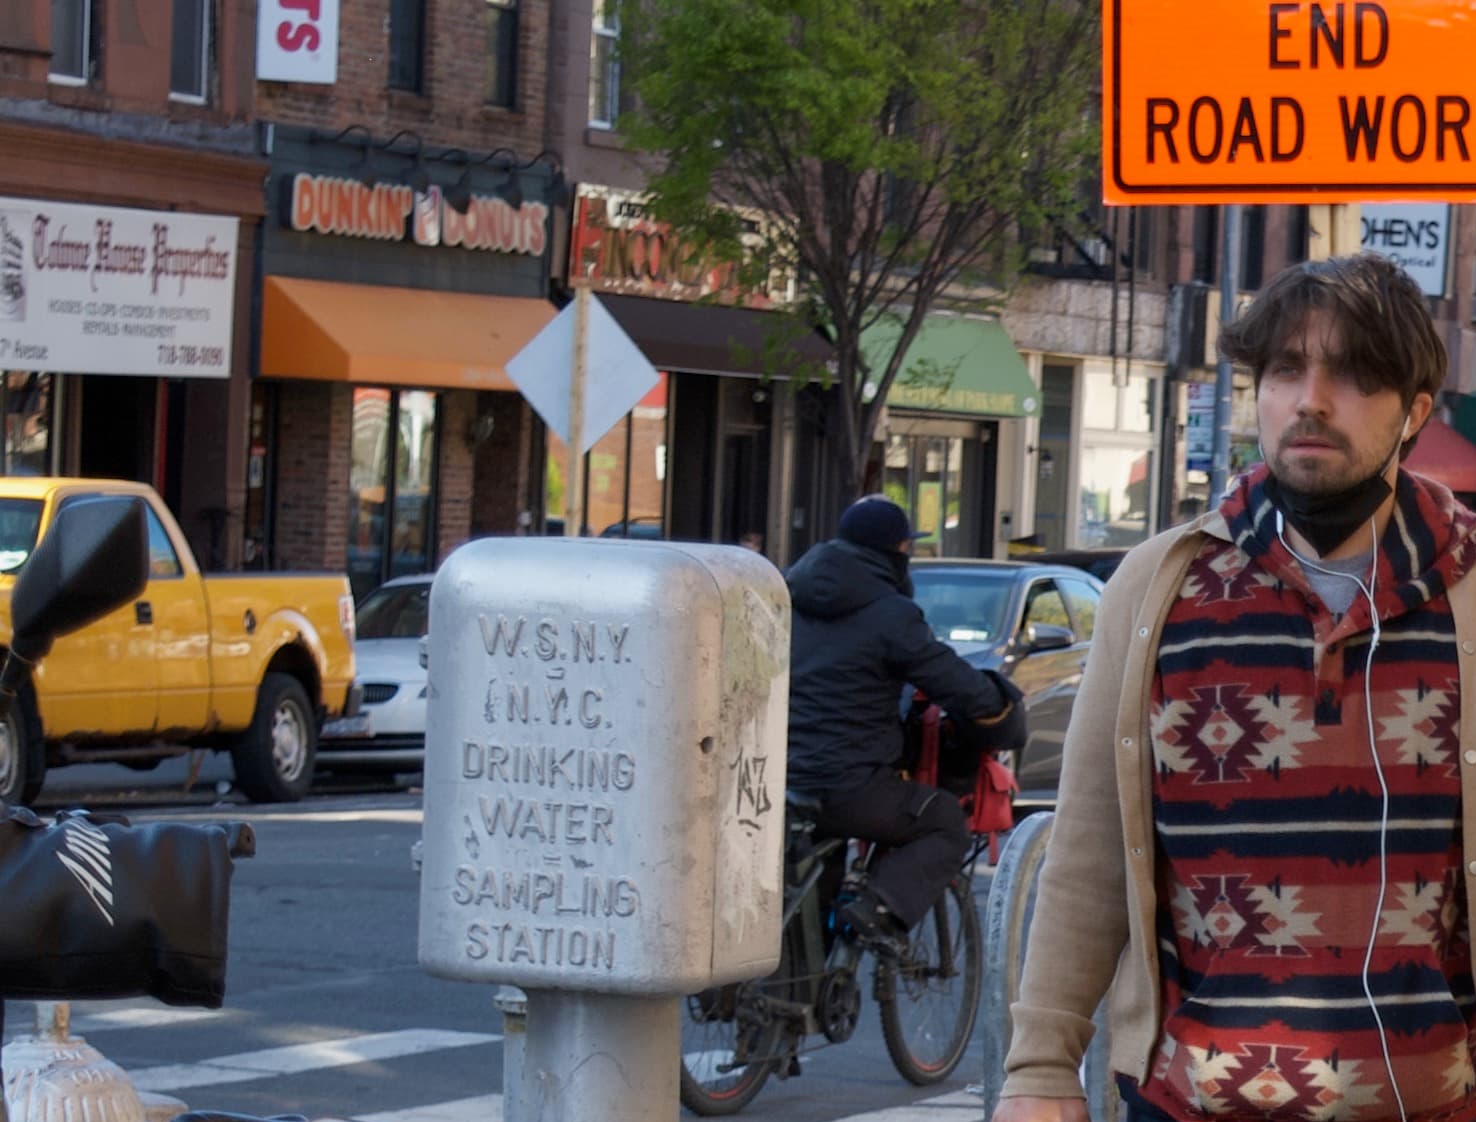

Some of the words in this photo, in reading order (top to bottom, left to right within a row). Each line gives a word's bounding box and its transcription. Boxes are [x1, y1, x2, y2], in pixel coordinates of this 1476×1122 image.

[1268, 2, 1390, 70] END
[1145, 96, 1305, 164] ROAD
[293, 173, 412, 241] DUNKIN'
[1361, 216, 1439, 249] HEN'S
[462, 738, 636, 792] DRINKING
[478, 794, 614, 846] WATER
[452, 863, 638, 918] SAMPLING
[465, 919, 617, 970] STATION
